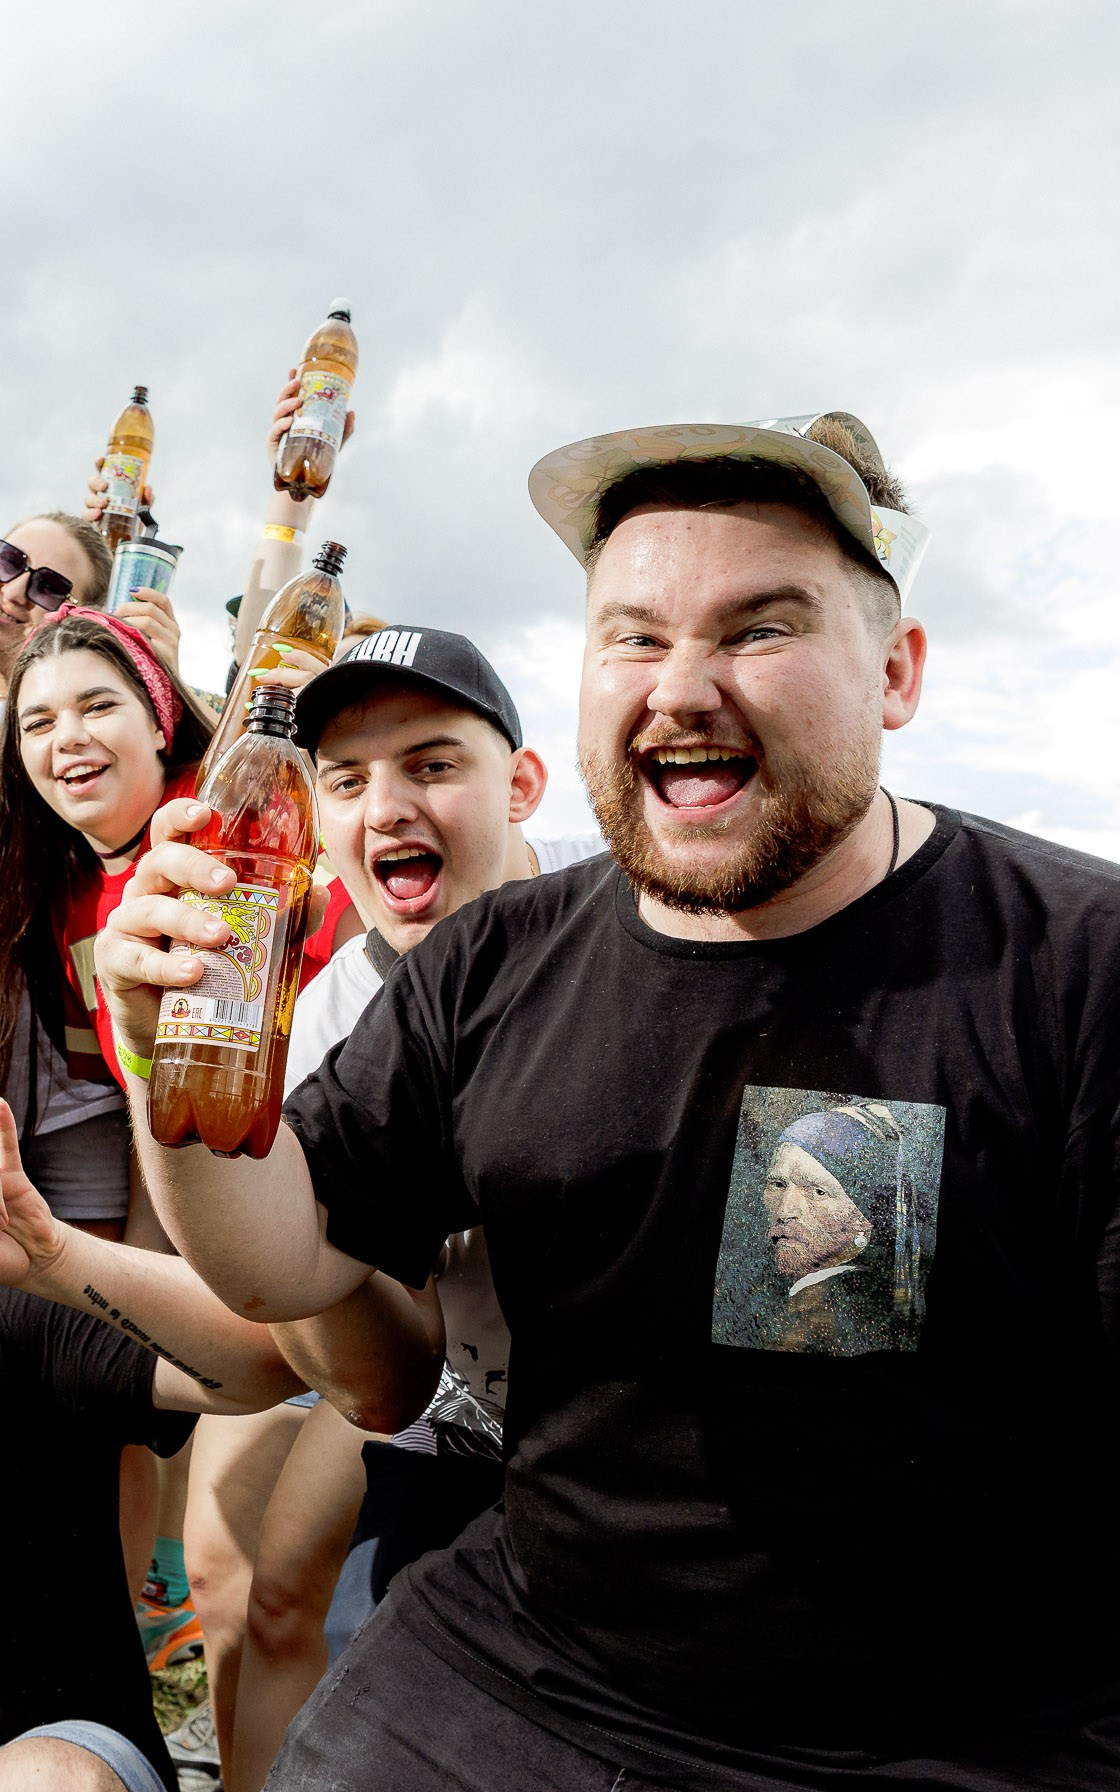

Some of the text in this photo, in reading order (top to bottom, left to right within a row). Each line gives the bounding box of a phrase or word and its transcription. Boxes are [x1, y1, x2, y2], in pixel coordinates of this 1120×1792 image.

[83, 1284, 109, 1310] mine
[109, 1308, 121, 1320] is
[120, 1318, 151, 1342] world
